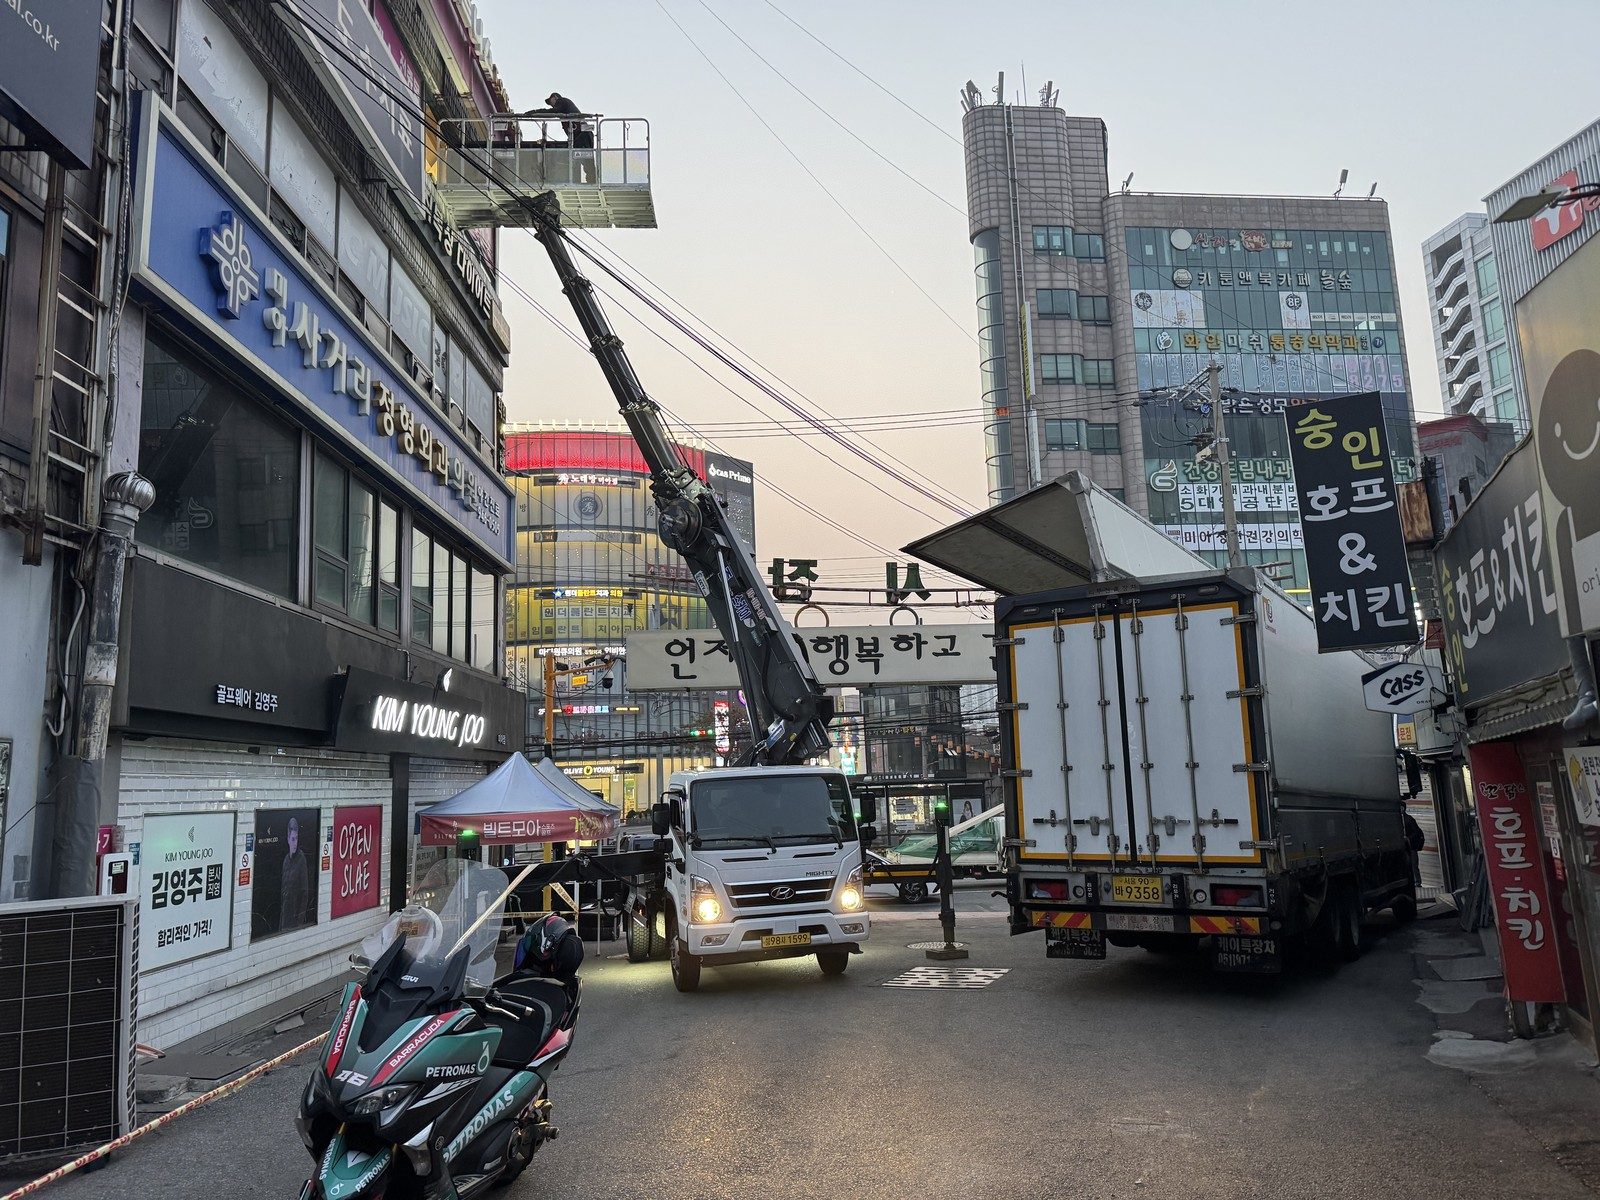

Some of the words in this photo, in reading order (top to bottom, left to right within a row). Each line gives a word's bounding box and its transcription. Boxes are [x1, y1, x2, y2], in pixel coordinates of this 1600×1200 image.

[457, 242, 492, 320] 다이어트
[1198, 271, 1312, 286] 카툰앤북카페
[1295, 408, 1384, 471] 숭인
[571, 474, 597, 484] 노래방
[729, 470, 752, 484] Prime
[1305, 477, 1395, 521] 호프
[1338, 532, 1378, 576] &
[1320, 582, 1409, 631] 치킨
[808, 633, 961, 676] 행복하고
[217, 684, 252, 708] 골프웨어
[255, 692, 278, 712] 김영주
[1380, 669, 1425, 698] Cass
[372, 695, 408, 732] KIM
[411, 703, 460, 741] YOUNG
[458, 713, 485, 747] JOO
[564, 767, 583, 775] OLIVE
[594, 766, 616, 774] YOUNG
[339, 822, 372, 860] OPEN
[484, 819, 541, 839] 빌트모아
[165, 852, 178, 863] KIM
[178, 849, 201, 860] YOUNG
[201, 847, 214, 860] JOO
[152, 867, 203, 909] 김영주
[208, 867, 222, 882] 본사
[207, 882, 221, 898] 직영
[341, 860, 371, 898] SLAE
[1115, 886, 1124, 896] 바
[1125, 886, 1160, 899] 9358
[1138, 877, 1149, 885] 90
[157, 923, 191, 948] 합리적인
[193, 919, 213, 938] 가격!
[788, 933, 808, 944] 1599
[1217, 936, 1276, 956] 케이특장차
[333, 999, 357, 1056] BARRACUDA
[390, 1018, 445, 1068] BARRACUDA
[335, 1069, 368, 1087] 46
[425, 1063, 476, 1078] PETRONAS
[443, 1089, 515, 1163] PETRONAS
[319, 1138, 336, 1181] PETRONAS
[356, 1153, 392, 1193] PETRONAS
